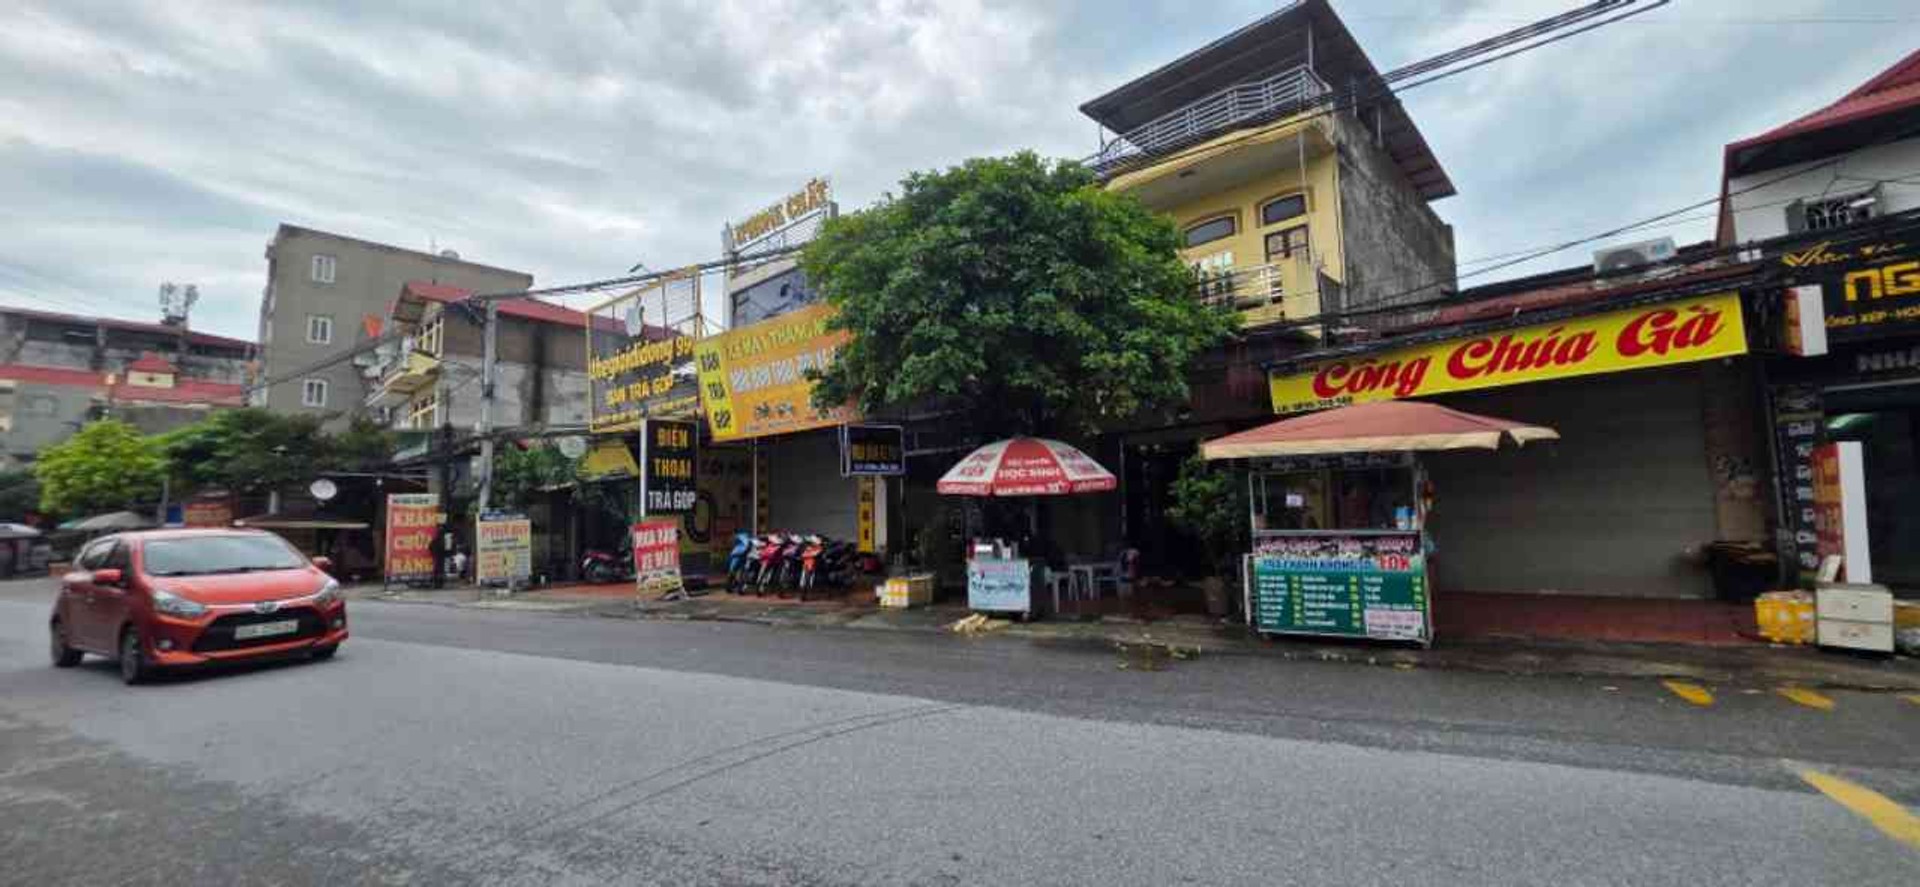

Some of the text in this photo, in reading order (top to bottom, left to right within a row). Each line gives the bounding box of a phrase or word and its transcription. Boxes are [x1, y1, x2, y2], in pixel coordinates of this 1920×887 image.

[1312, 355, 1431, 398] Công
[1447, 326, 1598, 380] Chúa
[1615, 304, 1724, 358] Gà
[649, 482, 696, 510] TRẢ GÓP
